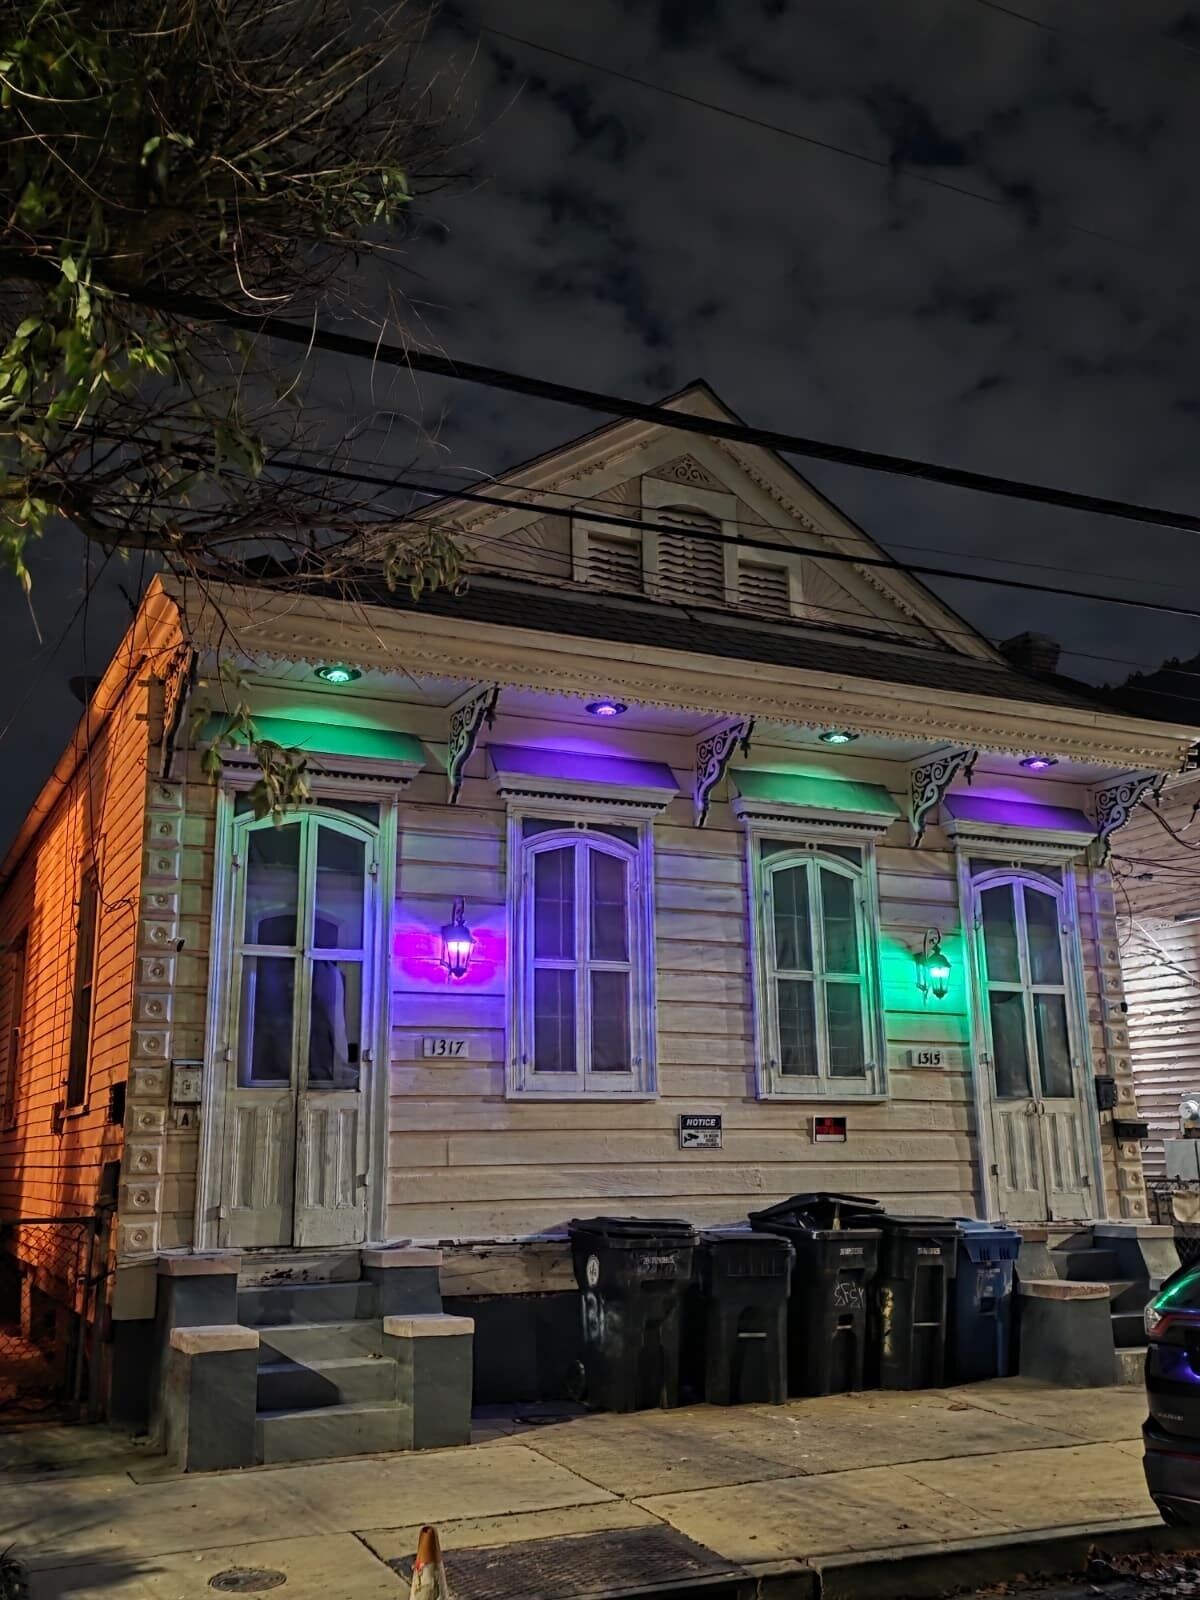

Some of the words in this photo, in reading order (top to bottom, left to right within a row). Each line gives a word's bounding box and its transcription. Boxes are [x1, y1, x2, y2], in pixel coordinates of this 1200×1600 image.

[431, 1039, 465, 1056] 1317
[918, 1052, 941, 1065] 1315
[686, 1118, 717, 1127] NOTICE
